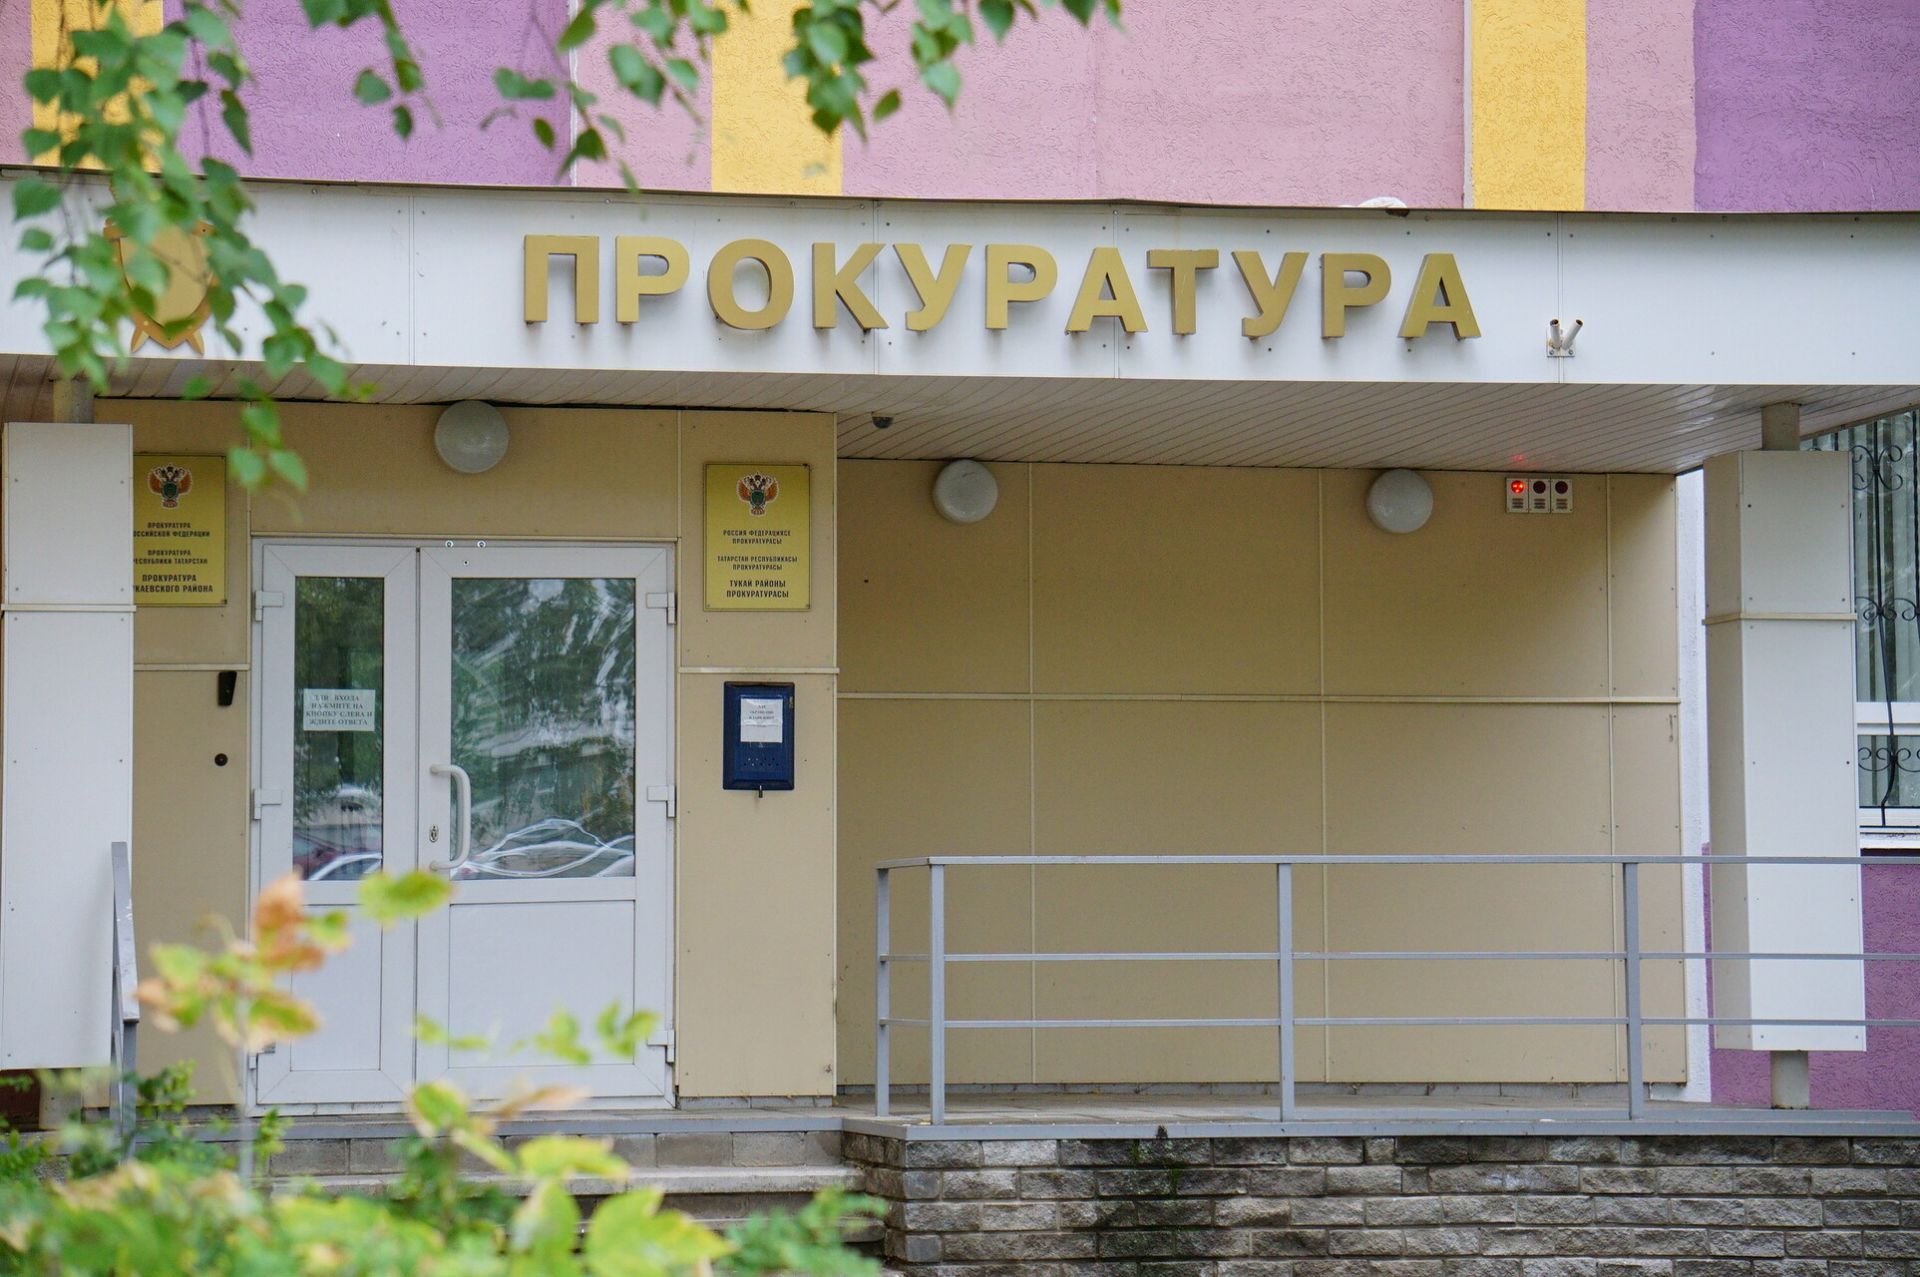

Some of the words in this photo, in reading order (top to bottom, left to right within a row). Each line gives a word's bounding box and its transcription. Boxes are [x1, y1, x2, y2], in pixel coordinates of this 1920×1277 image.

[522, 233, 1482, 339] ПРОКУРАТУРА
[142, 574, 197, 582] ПРОКУРАТУРА
[133, 585, 180, 593] КАЕВСКОГО
[183, 583, 213, 593] РАЙОНА
[755, 579, 786, 588] РАЙОНЫ
[726, 590, 789, 598] ПРОКУРАТУРАСЫ
